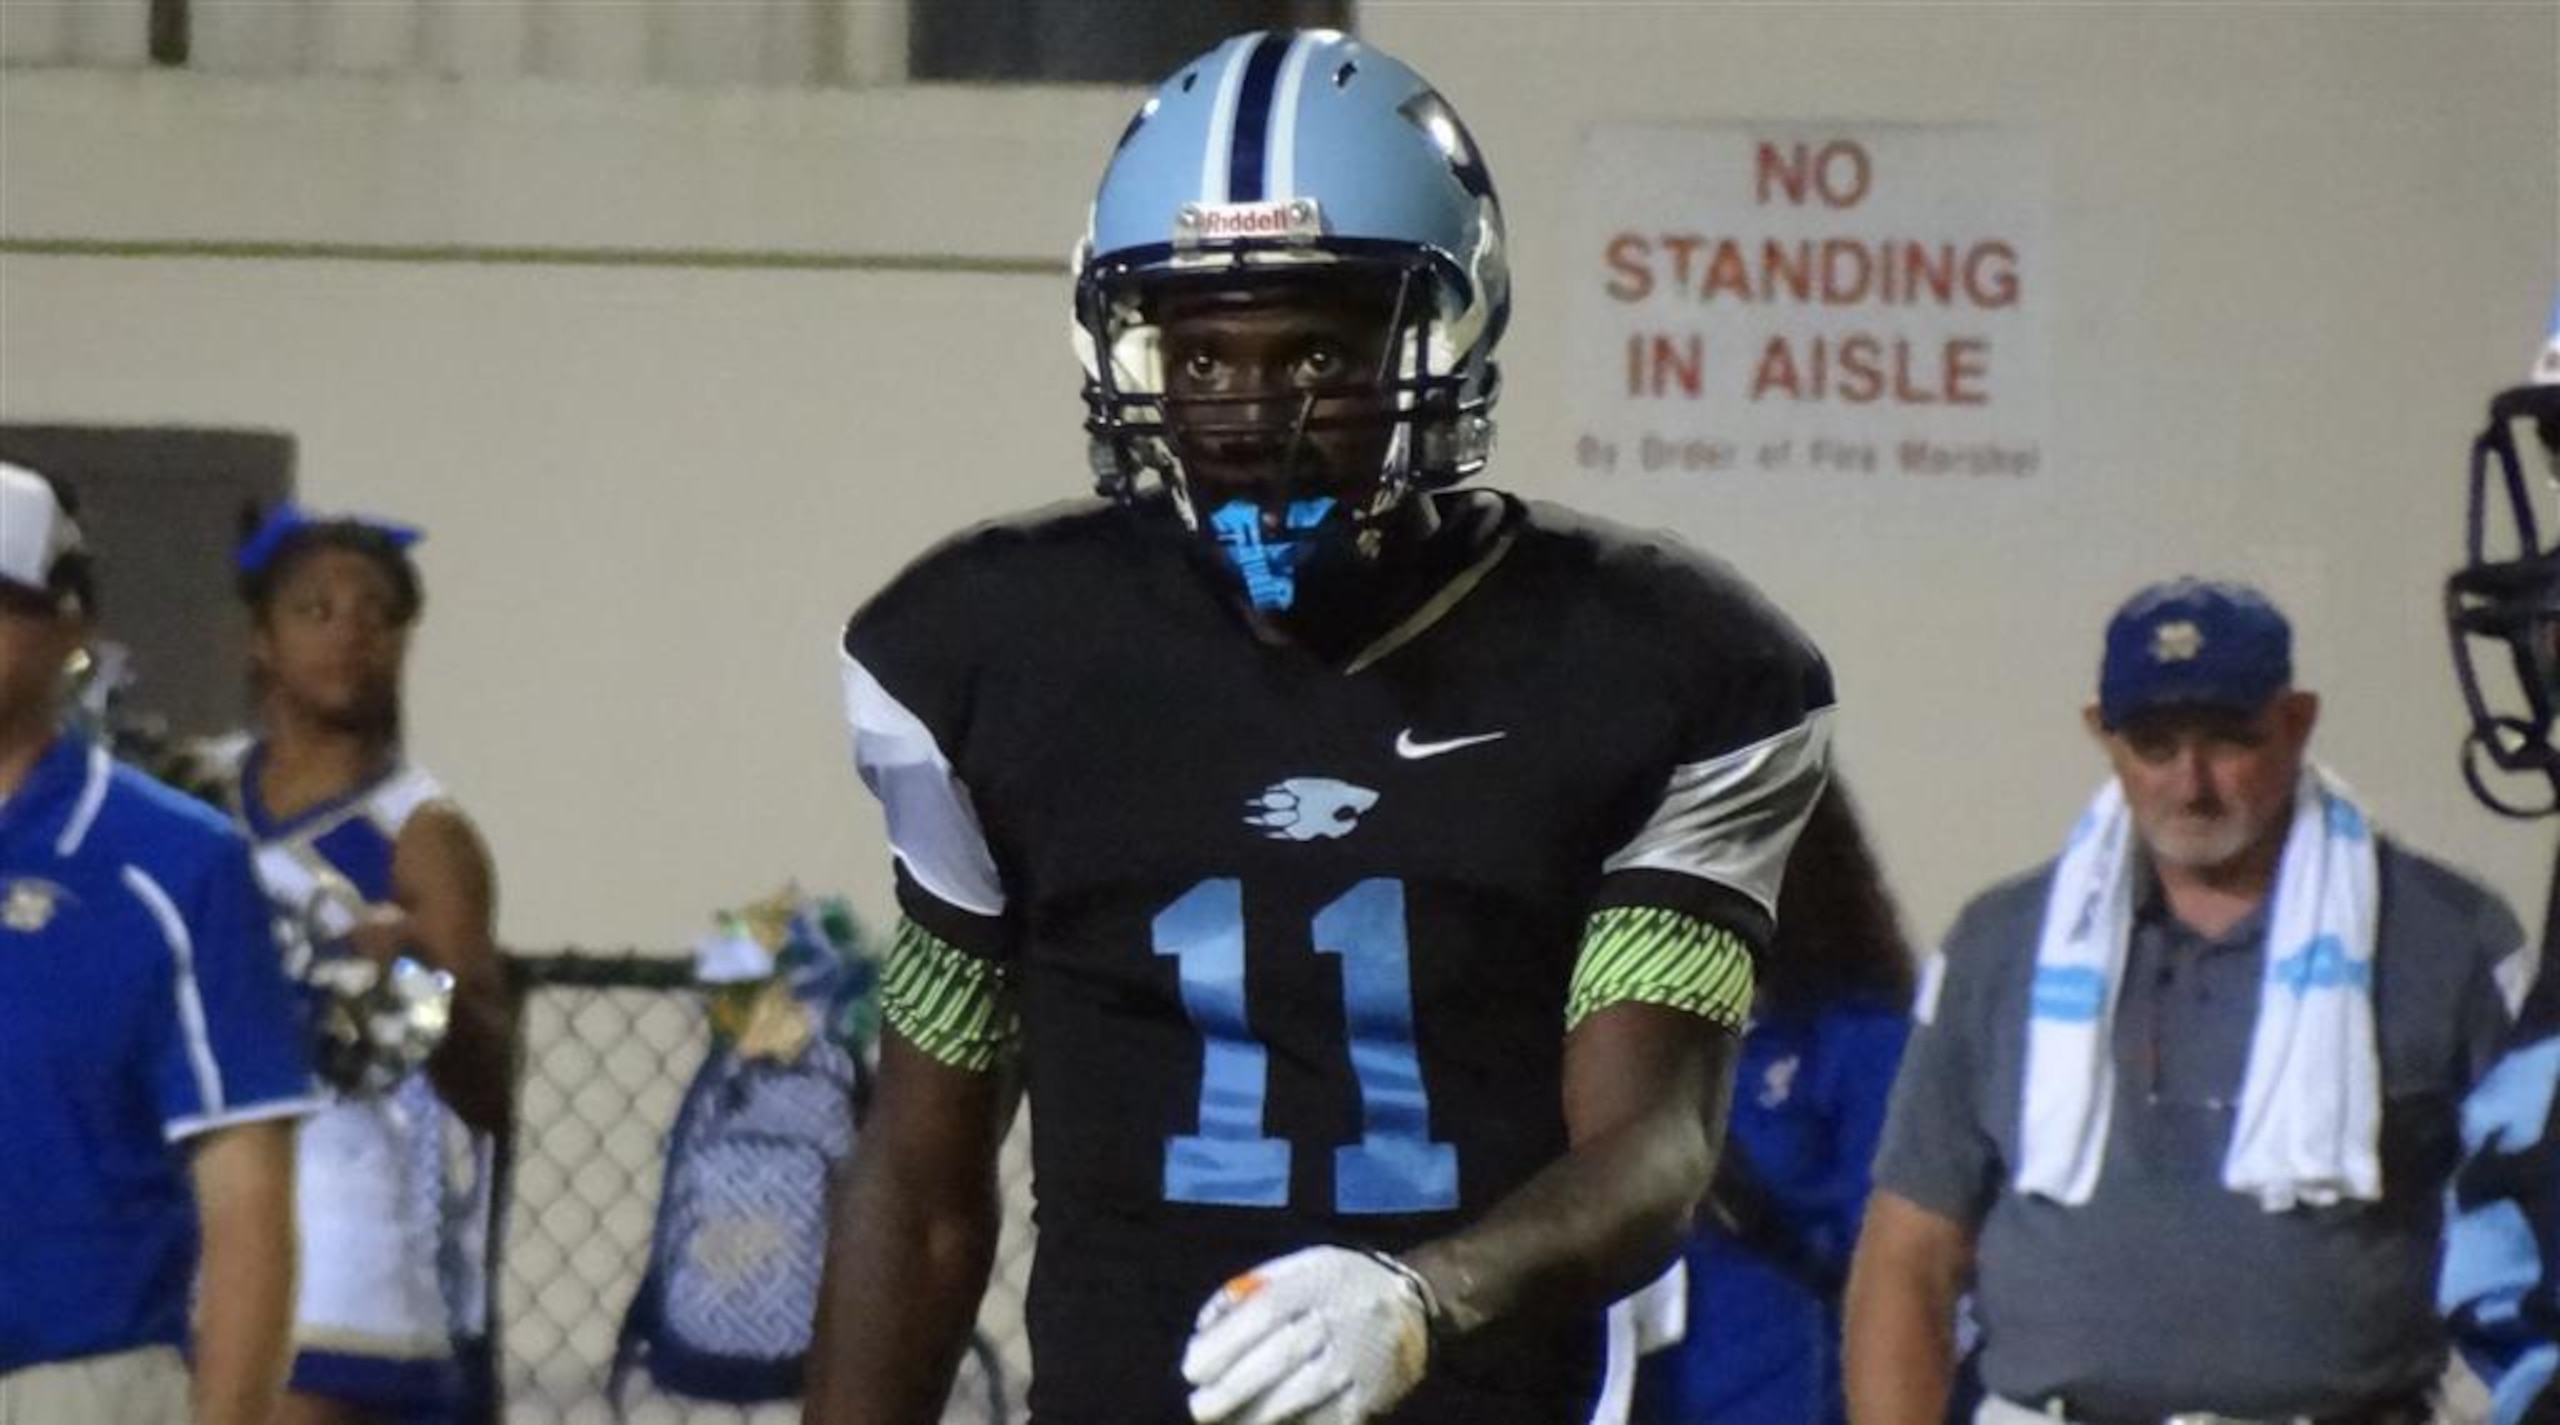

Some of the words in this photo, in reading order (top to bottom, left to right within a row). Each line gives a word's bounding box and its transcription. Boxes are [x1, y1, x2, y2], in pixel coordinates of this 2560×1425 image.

[1756, 139, 1872, 208] NO
[1199, 205, 1288, 233] Riddell
[1604, 232, 2022, 308] STANDING
[1627, 334, 1703, 399] IN
[1750, 334, 1990, 405] AISLE
[1576, 434, 1619, 474] By
[1640, 436, 1738, 473] Order
[1757, 439, 1793, 470] of
[1808, 438, 1878, 474] Fire
[1151, 876, 1460, 1214] 11
